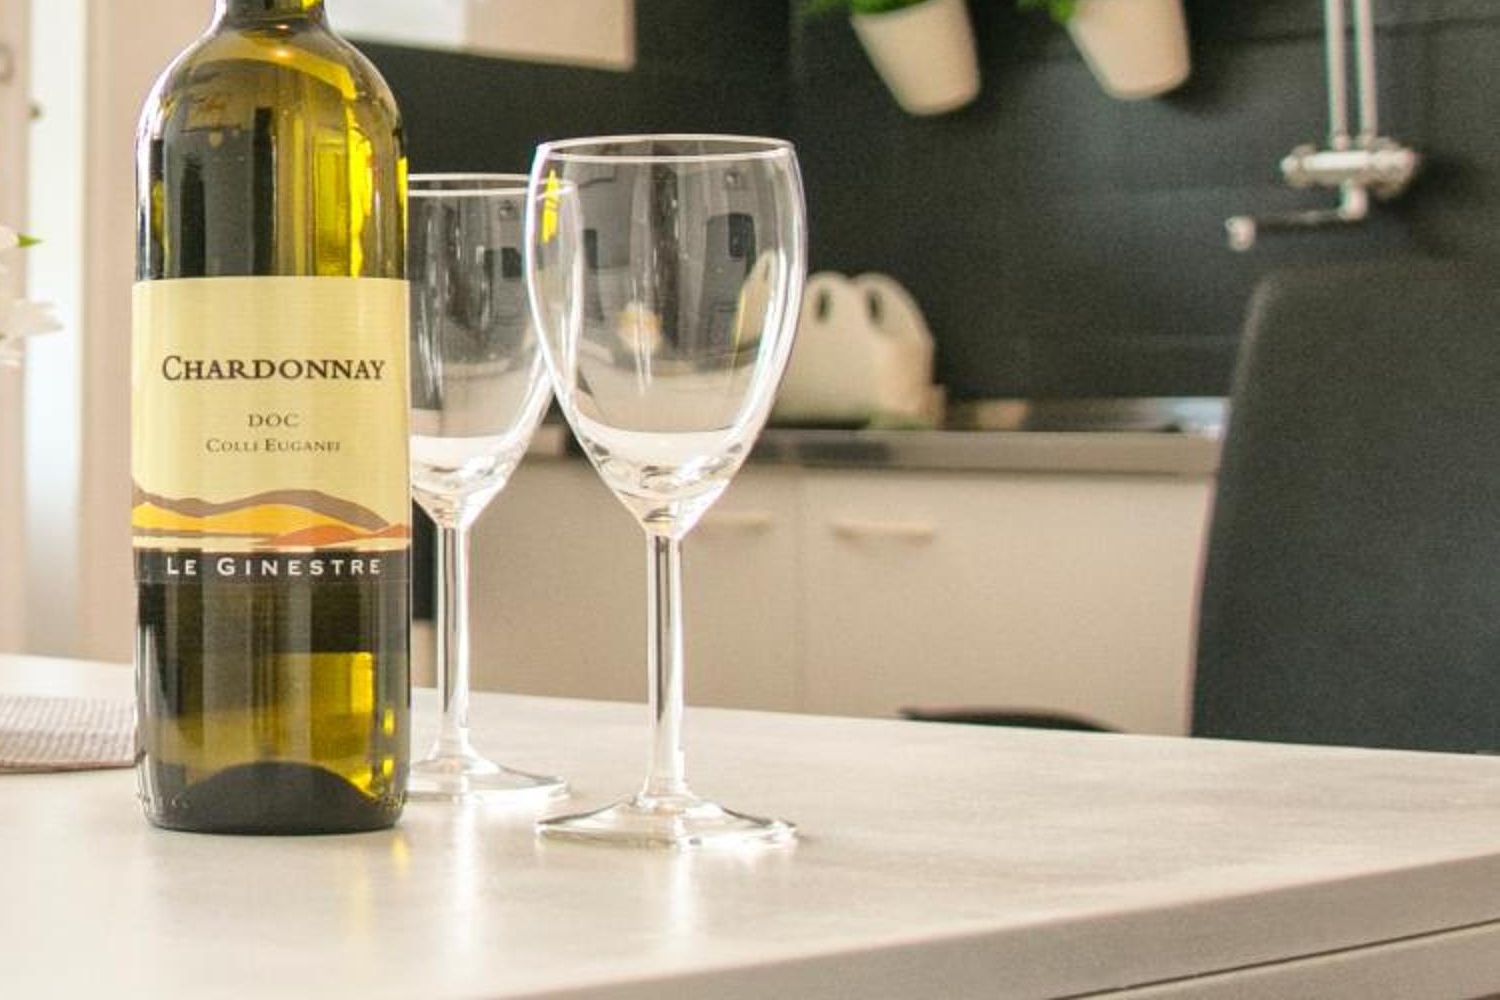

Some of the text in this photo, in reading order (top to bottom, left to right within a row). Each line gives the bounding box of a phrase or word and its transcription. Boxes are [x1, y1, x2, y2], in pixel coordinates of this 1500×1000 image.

[161, 354, 386, 382] CHARDONNAY
[247, 413, 299, 428] DOC
[205, 438, 259, 453] COLLI
[166, 556, 382, 577] LE GINESTRE
